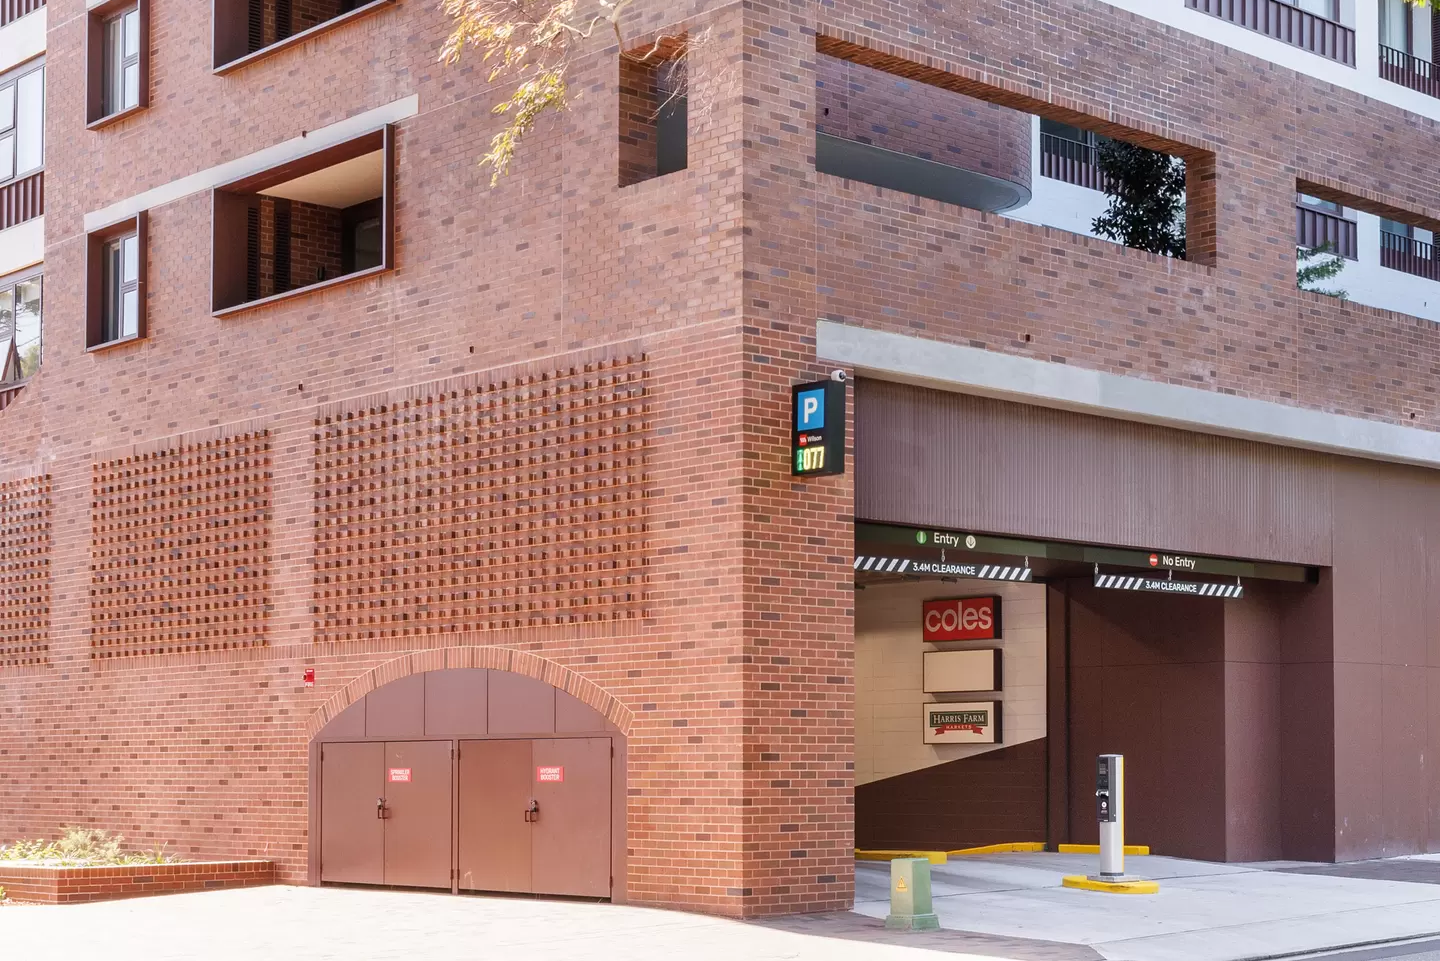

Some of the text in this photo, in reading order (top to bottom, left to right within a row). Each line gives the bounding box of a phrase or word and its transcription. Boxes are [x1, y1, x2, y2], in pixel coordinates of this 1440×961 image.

[803, 397, 818, 424] P
[807, 435, 823, 443] Wilson
[803, 446, 825, 471] 077
[934, 533, 959, 547] Entry
[912, 562, 976, 576] 3.4M CLEARANCE
[1162, 555, 1196, 570] No Entry
[1145, 580, 1197, 593] 3.4M CLEARANCE
[925, 601, 992, 633] coles
[933, 713, 985, 724] HARRIS FARM
